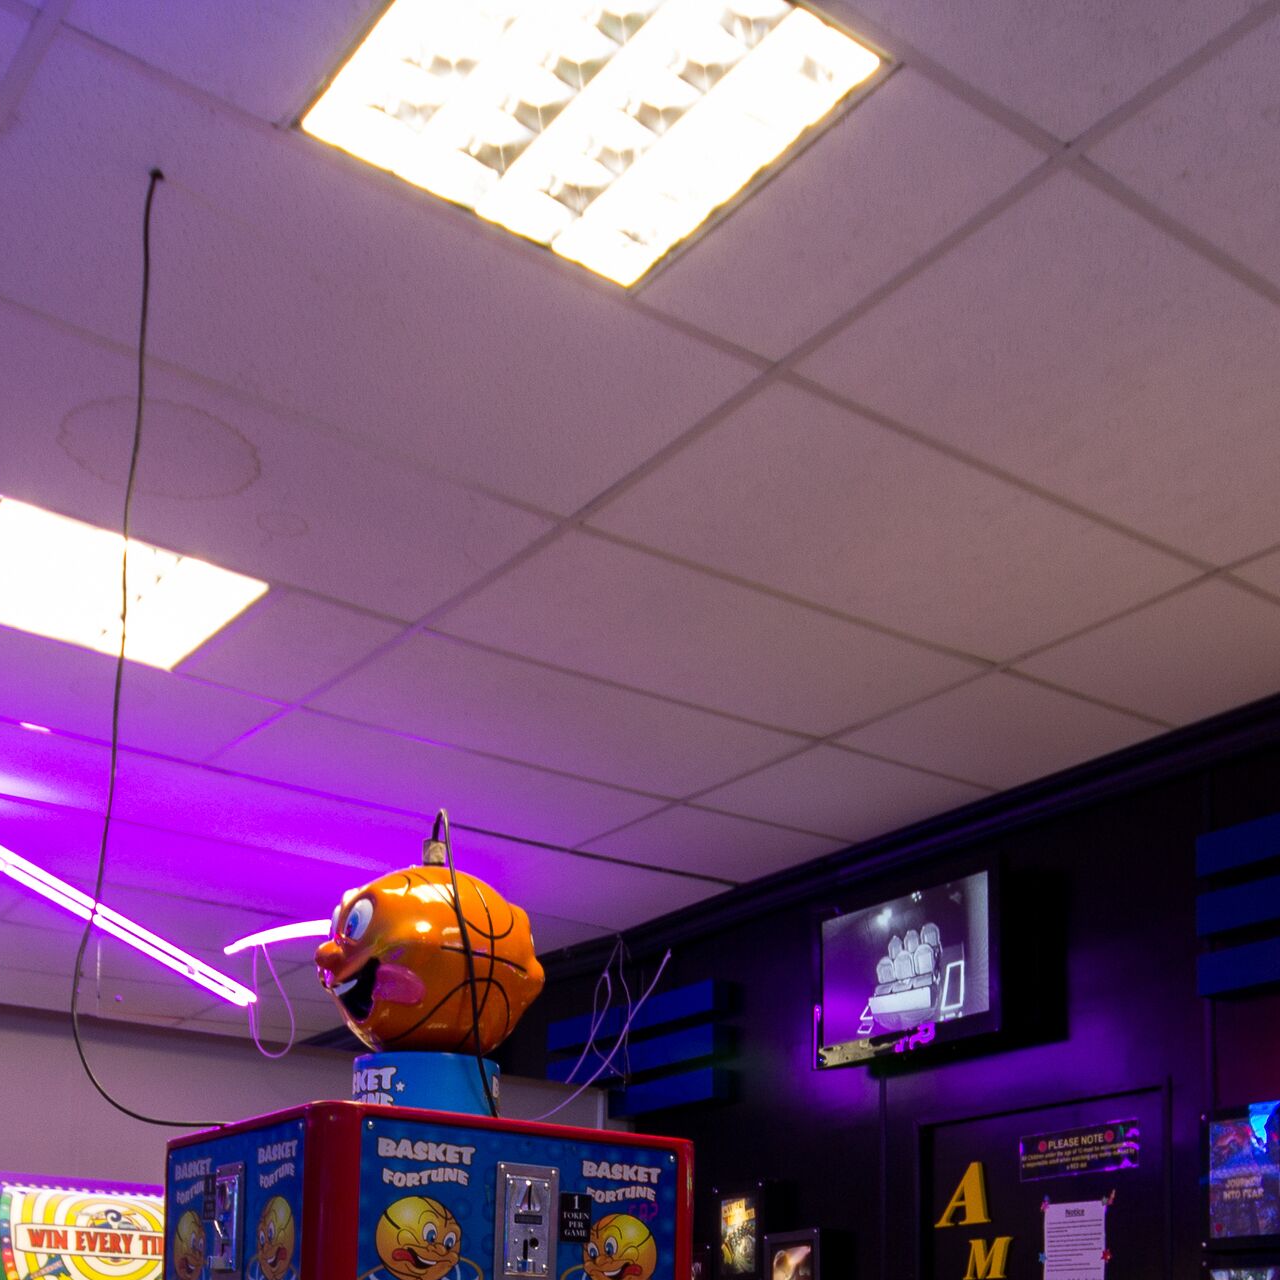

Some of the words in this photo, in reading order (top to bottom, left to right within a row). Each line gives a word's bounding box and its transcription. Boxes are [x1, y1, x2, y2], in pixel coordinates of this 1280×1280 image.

[257, 1140, 298, 1164] BASKET
[377, 1136, 477, 1166] BASKET
[1048, 1136, 1080, 1150] PLEASE
[1081, 1133, 1104, 1145] NOTE
[174, 1158, 212, 1181] BASKET
[259, 1162, 296, 1189] FORTUNE
[382, 1166, 470, 1188] FORTUNE
[581, 1160, 662, 1184] BASKET
[176, 1181, 205, 1205] FORTUN
[573, 1195, 580, 1210] 1
[586, 1185, 657, 1204] FORTUNE
[1242, 1188, 1264, 1200] FEAR
[562, 1211, 590, 1220] TOKEN
[568, 1219, 584, 1229] PER
[27, 1228, 69, 1250] WIN
[74, 1230, 134, 1254] EVERY
[563, 1228, 588, 1238] GAME
